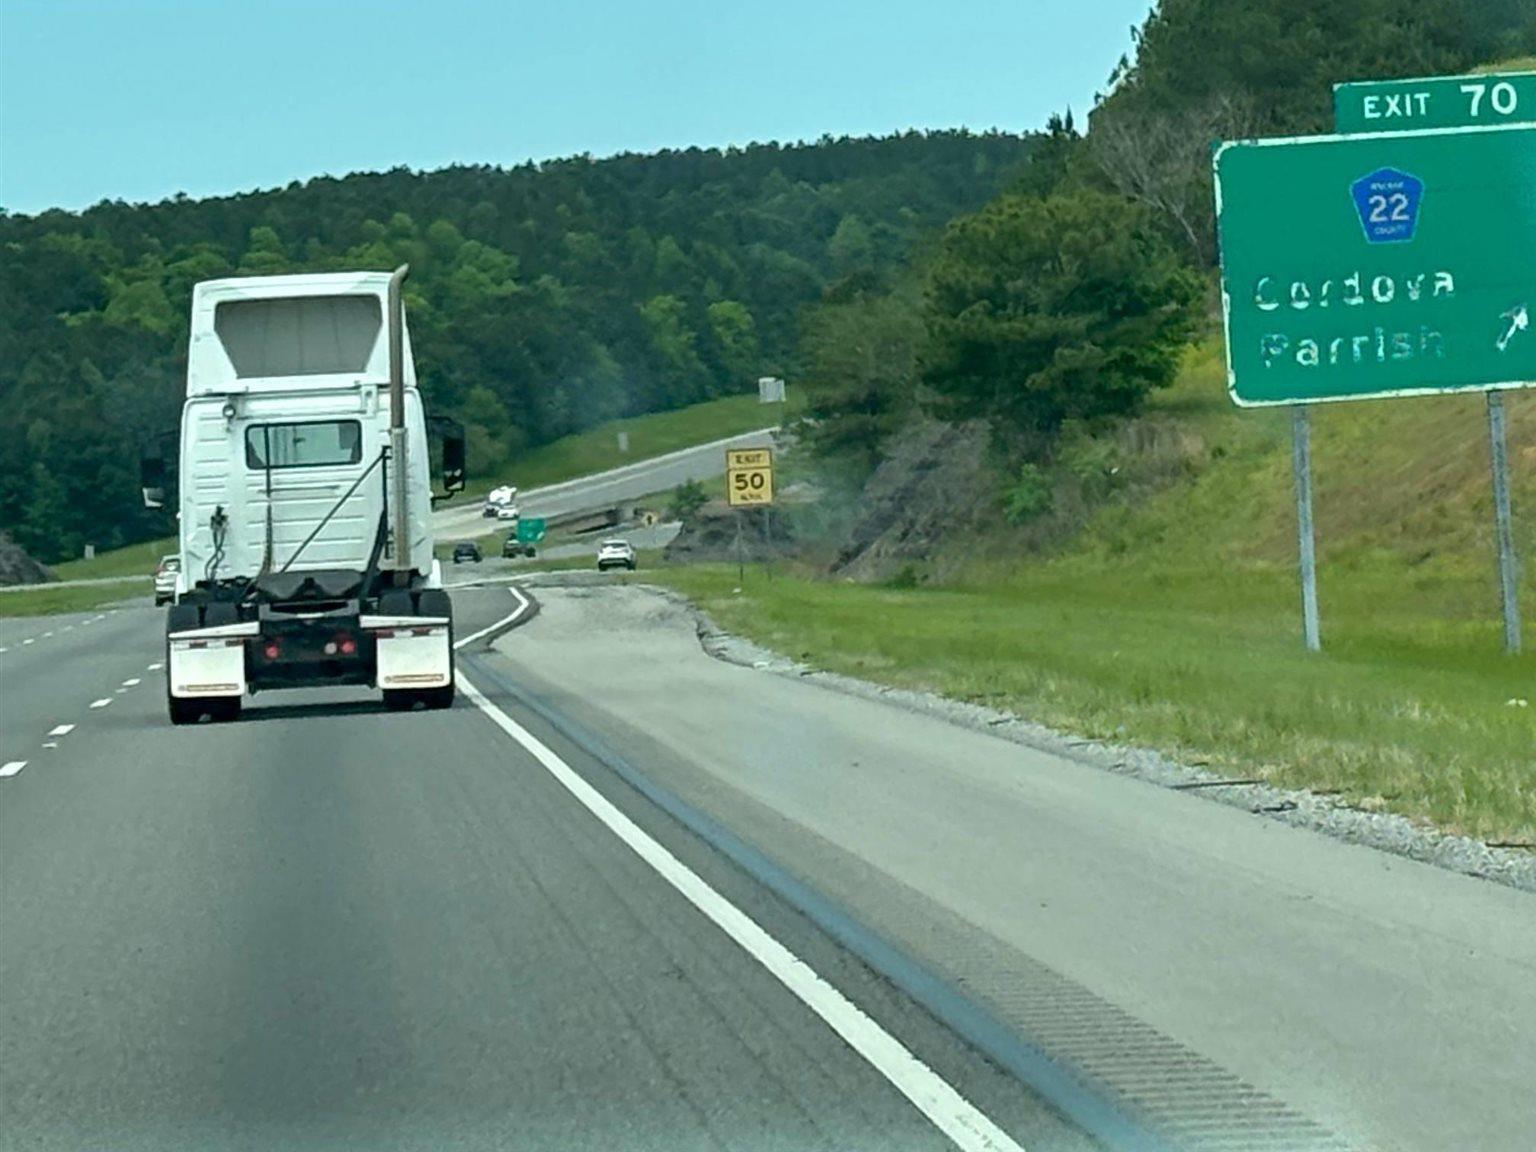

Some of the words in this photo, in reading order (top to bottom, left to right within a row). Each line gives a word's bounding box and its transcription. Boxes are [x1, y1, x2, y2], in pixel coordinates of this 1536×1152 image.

[1363, 92, 1431, 119] EXIT
[1460, 82, 1518, 117] 70
[1368, 192, 1410, 223] 22
[735, 472, 765, 491] 50
